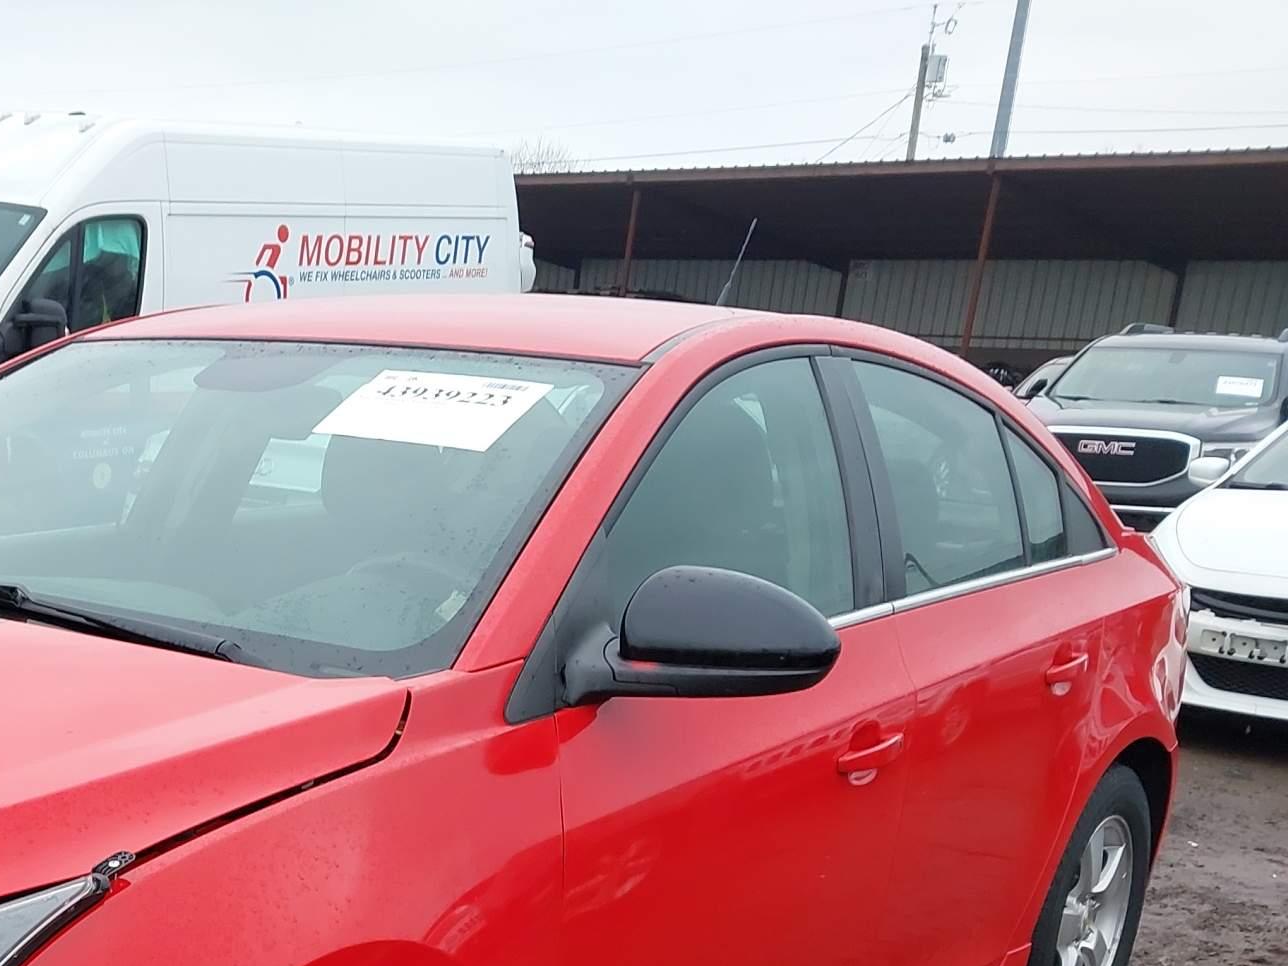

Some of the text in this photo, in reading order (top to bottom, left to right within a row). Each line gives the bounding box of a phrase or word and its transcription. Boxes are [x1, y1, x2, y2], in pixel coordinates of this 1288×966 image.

[298, 234, 491, 267] MOBILITY CITY
[299, 271, 313, 282] WE
[314, 271, 329, 282] FIX
[330, 270, 391, 282] WHEELCHAIRS
[399, 268, 441, 280] SCOOTERS
[448, 268, 464, 278] AND
[465, 267, 488, 278] MORE!
[377, 384, 512, 406] 43939223
[1078, 440, 1136, 456] GMC
